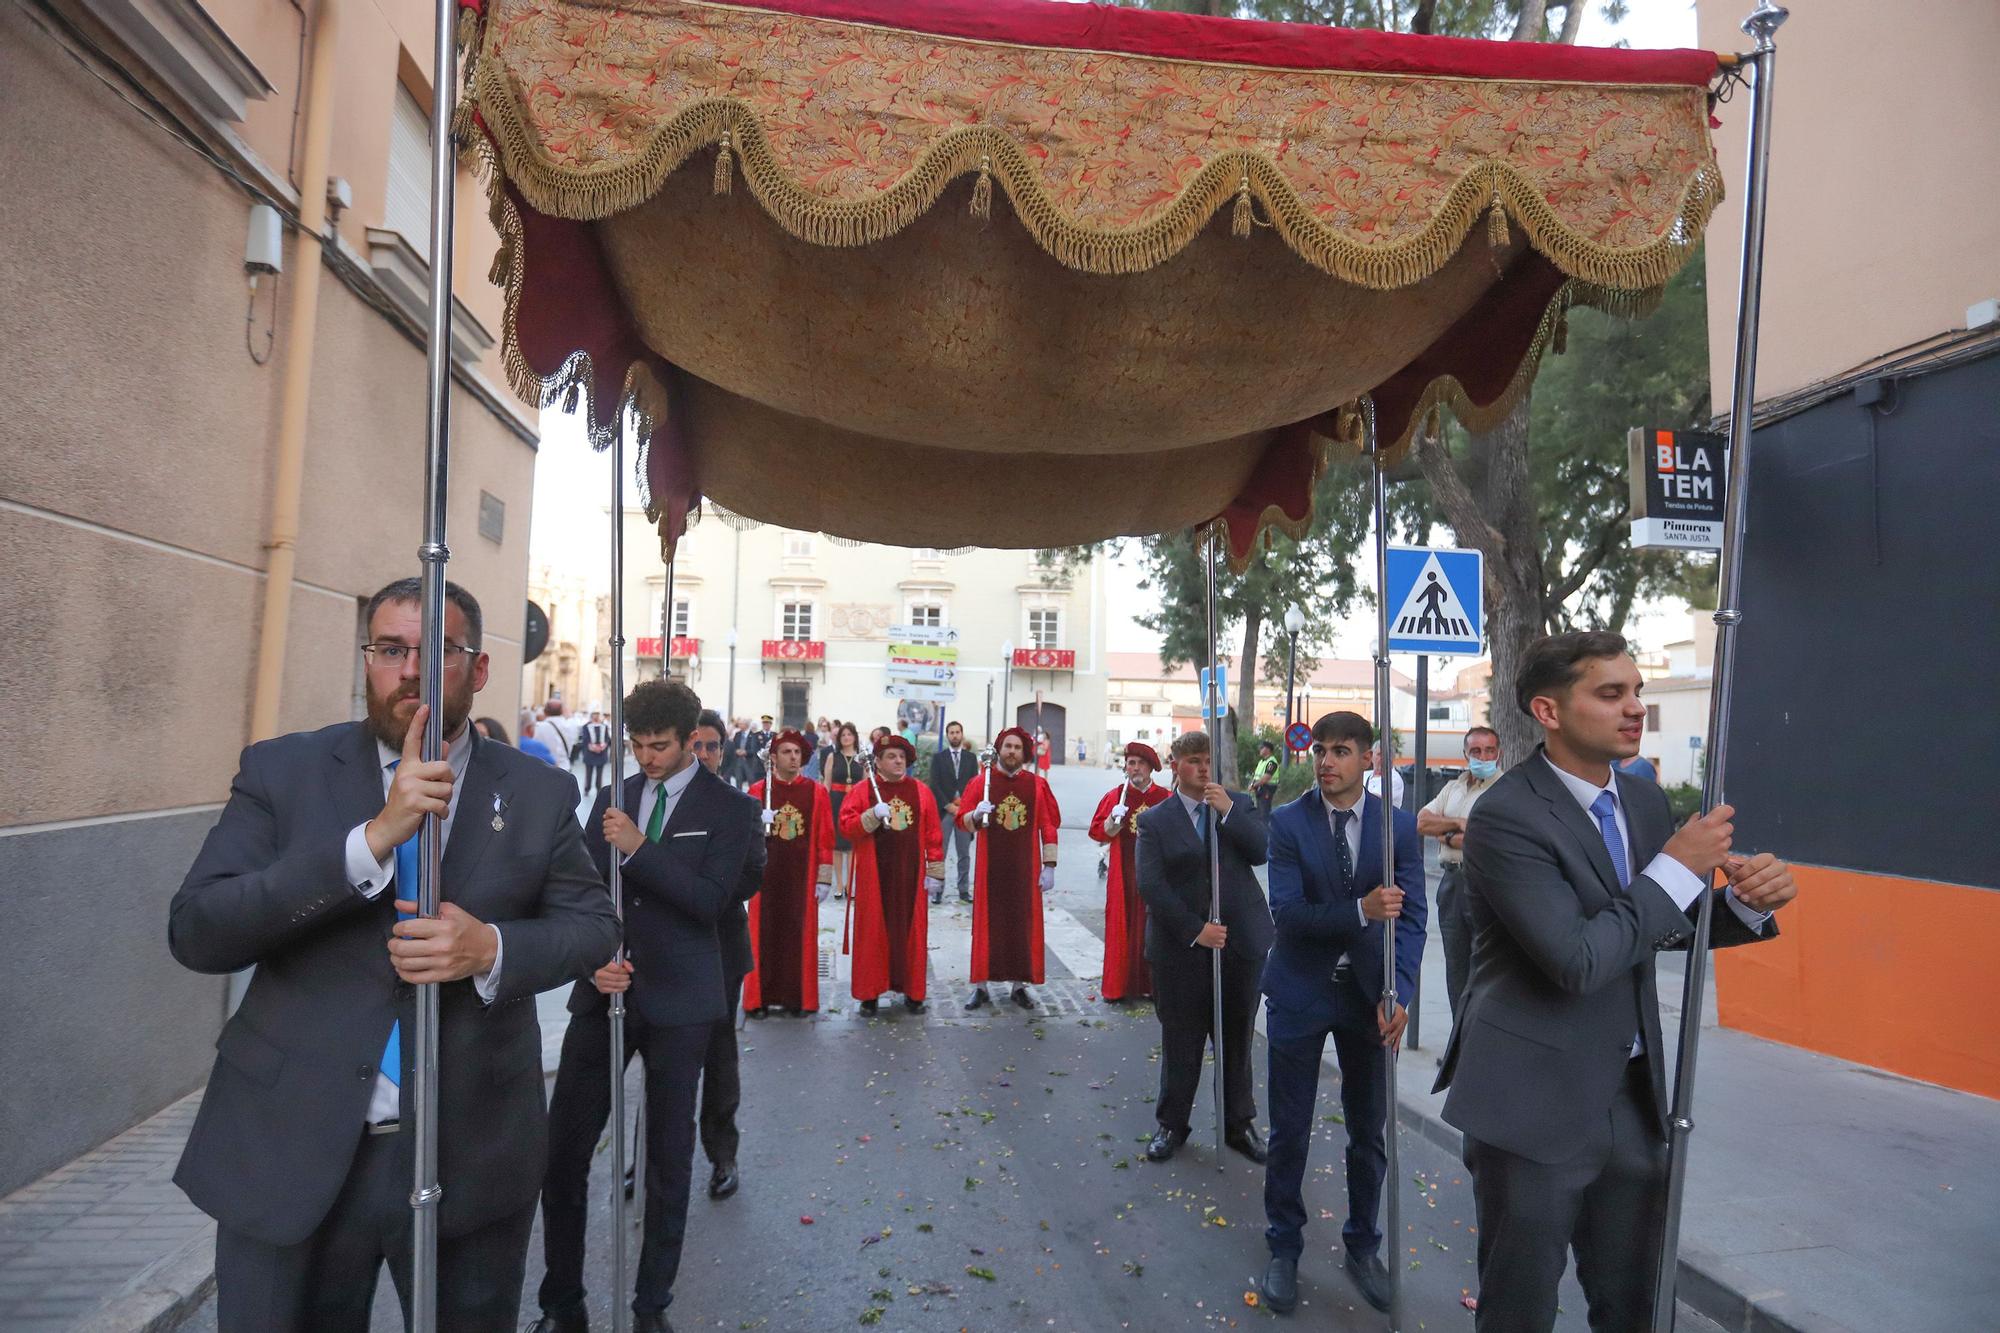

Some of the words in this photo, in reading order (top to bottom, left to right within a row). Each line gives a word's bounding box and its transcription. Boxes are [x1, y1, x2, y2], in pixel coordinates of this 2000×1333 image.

[1657, 444, 1712, 471] BLA
[1658, 473, 1713, 500] TEM
[1664, 501, 1685, 510] Tiendas
[1694, 502, 1714, 511] Pintura
[1663, 520, 1711, 533] Pinturas
[1664, 532, 1688, 542] SANTA
[1689, 533, 1711, 543] JUSTA
